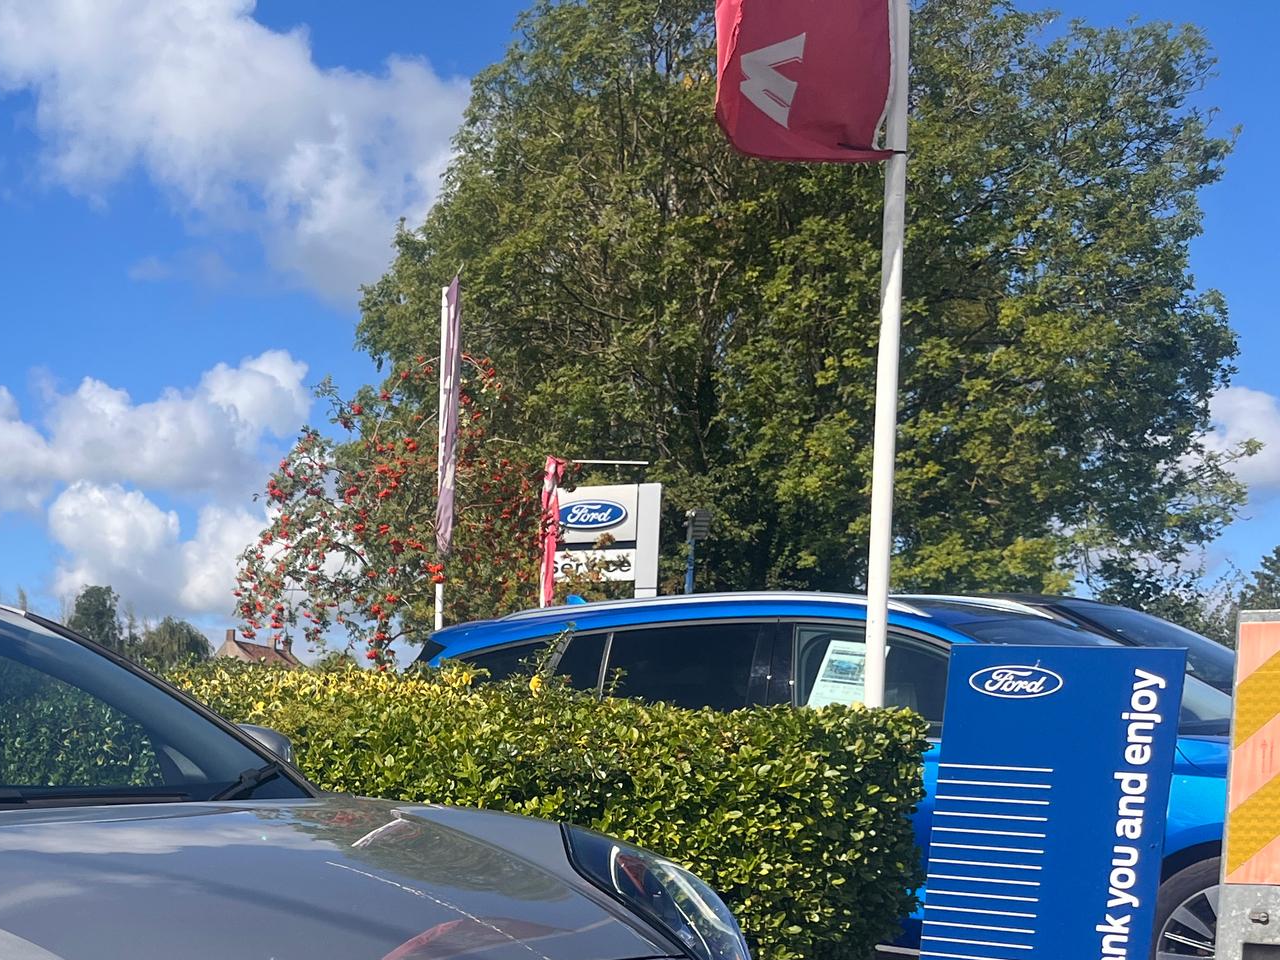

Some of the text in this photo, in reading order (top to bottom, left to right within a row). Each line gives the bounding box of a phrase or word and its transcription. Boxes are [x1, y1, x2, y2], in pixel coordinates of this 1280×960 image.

[567, 504, 613, 523] Ford
[553, 560, 631, 574] erce
[984, 669, 1047, 693] Ford
[1122, 668, 1165, 766] enjoy
[1114, 771, 1148, 839] and
[1107, 846, 1139, 908] you
